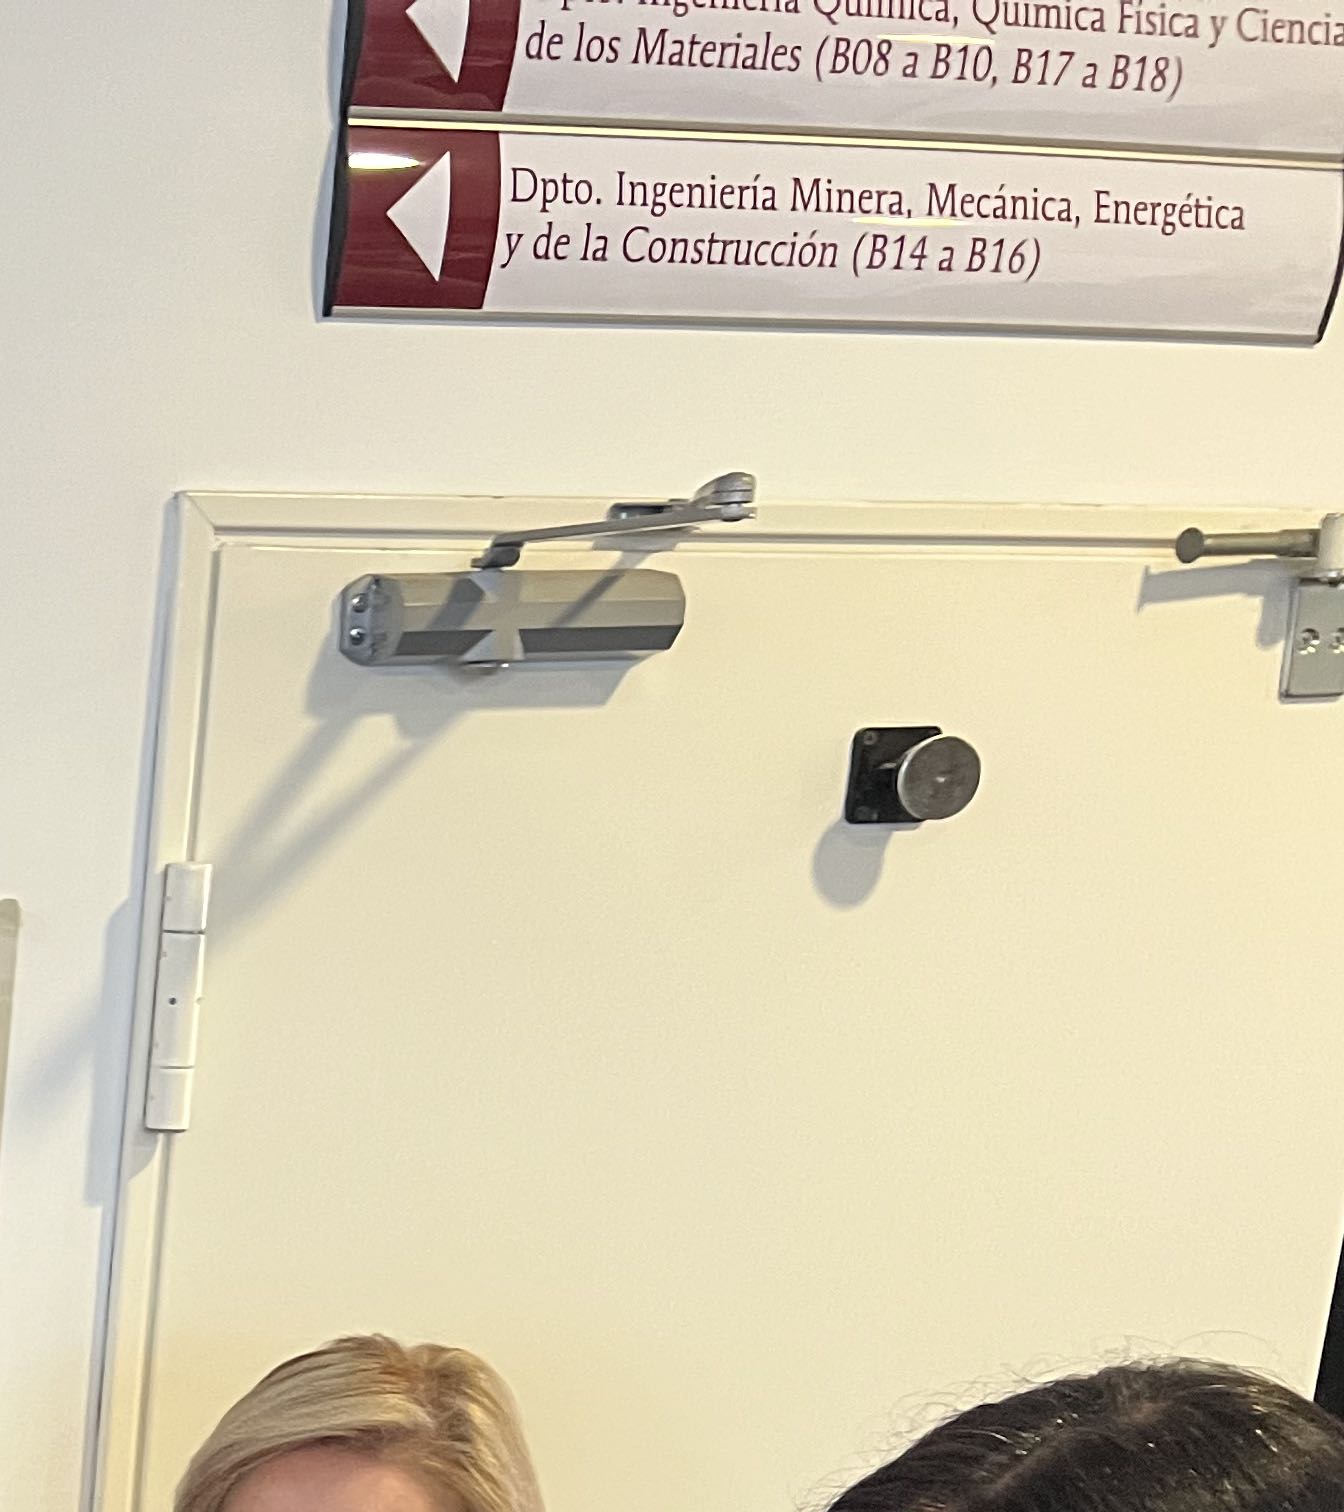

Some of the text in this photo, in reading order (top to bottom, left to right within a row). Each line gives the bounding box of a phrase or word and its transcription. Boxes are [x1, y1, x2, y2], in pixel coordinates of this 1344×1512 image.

[1117, 0, 1200, 38] Física
[1208, 15, 1227, 48] y
[524, 20, 1184, 102] de los Materiales (B08 a B10, B17 a B18)
[509, 166, 1246, 236] Dpto. Ingeniería Minera, Mecánica, Energética
[500, 222, 1041, 282] y de la Construcción (B14 a B16)
